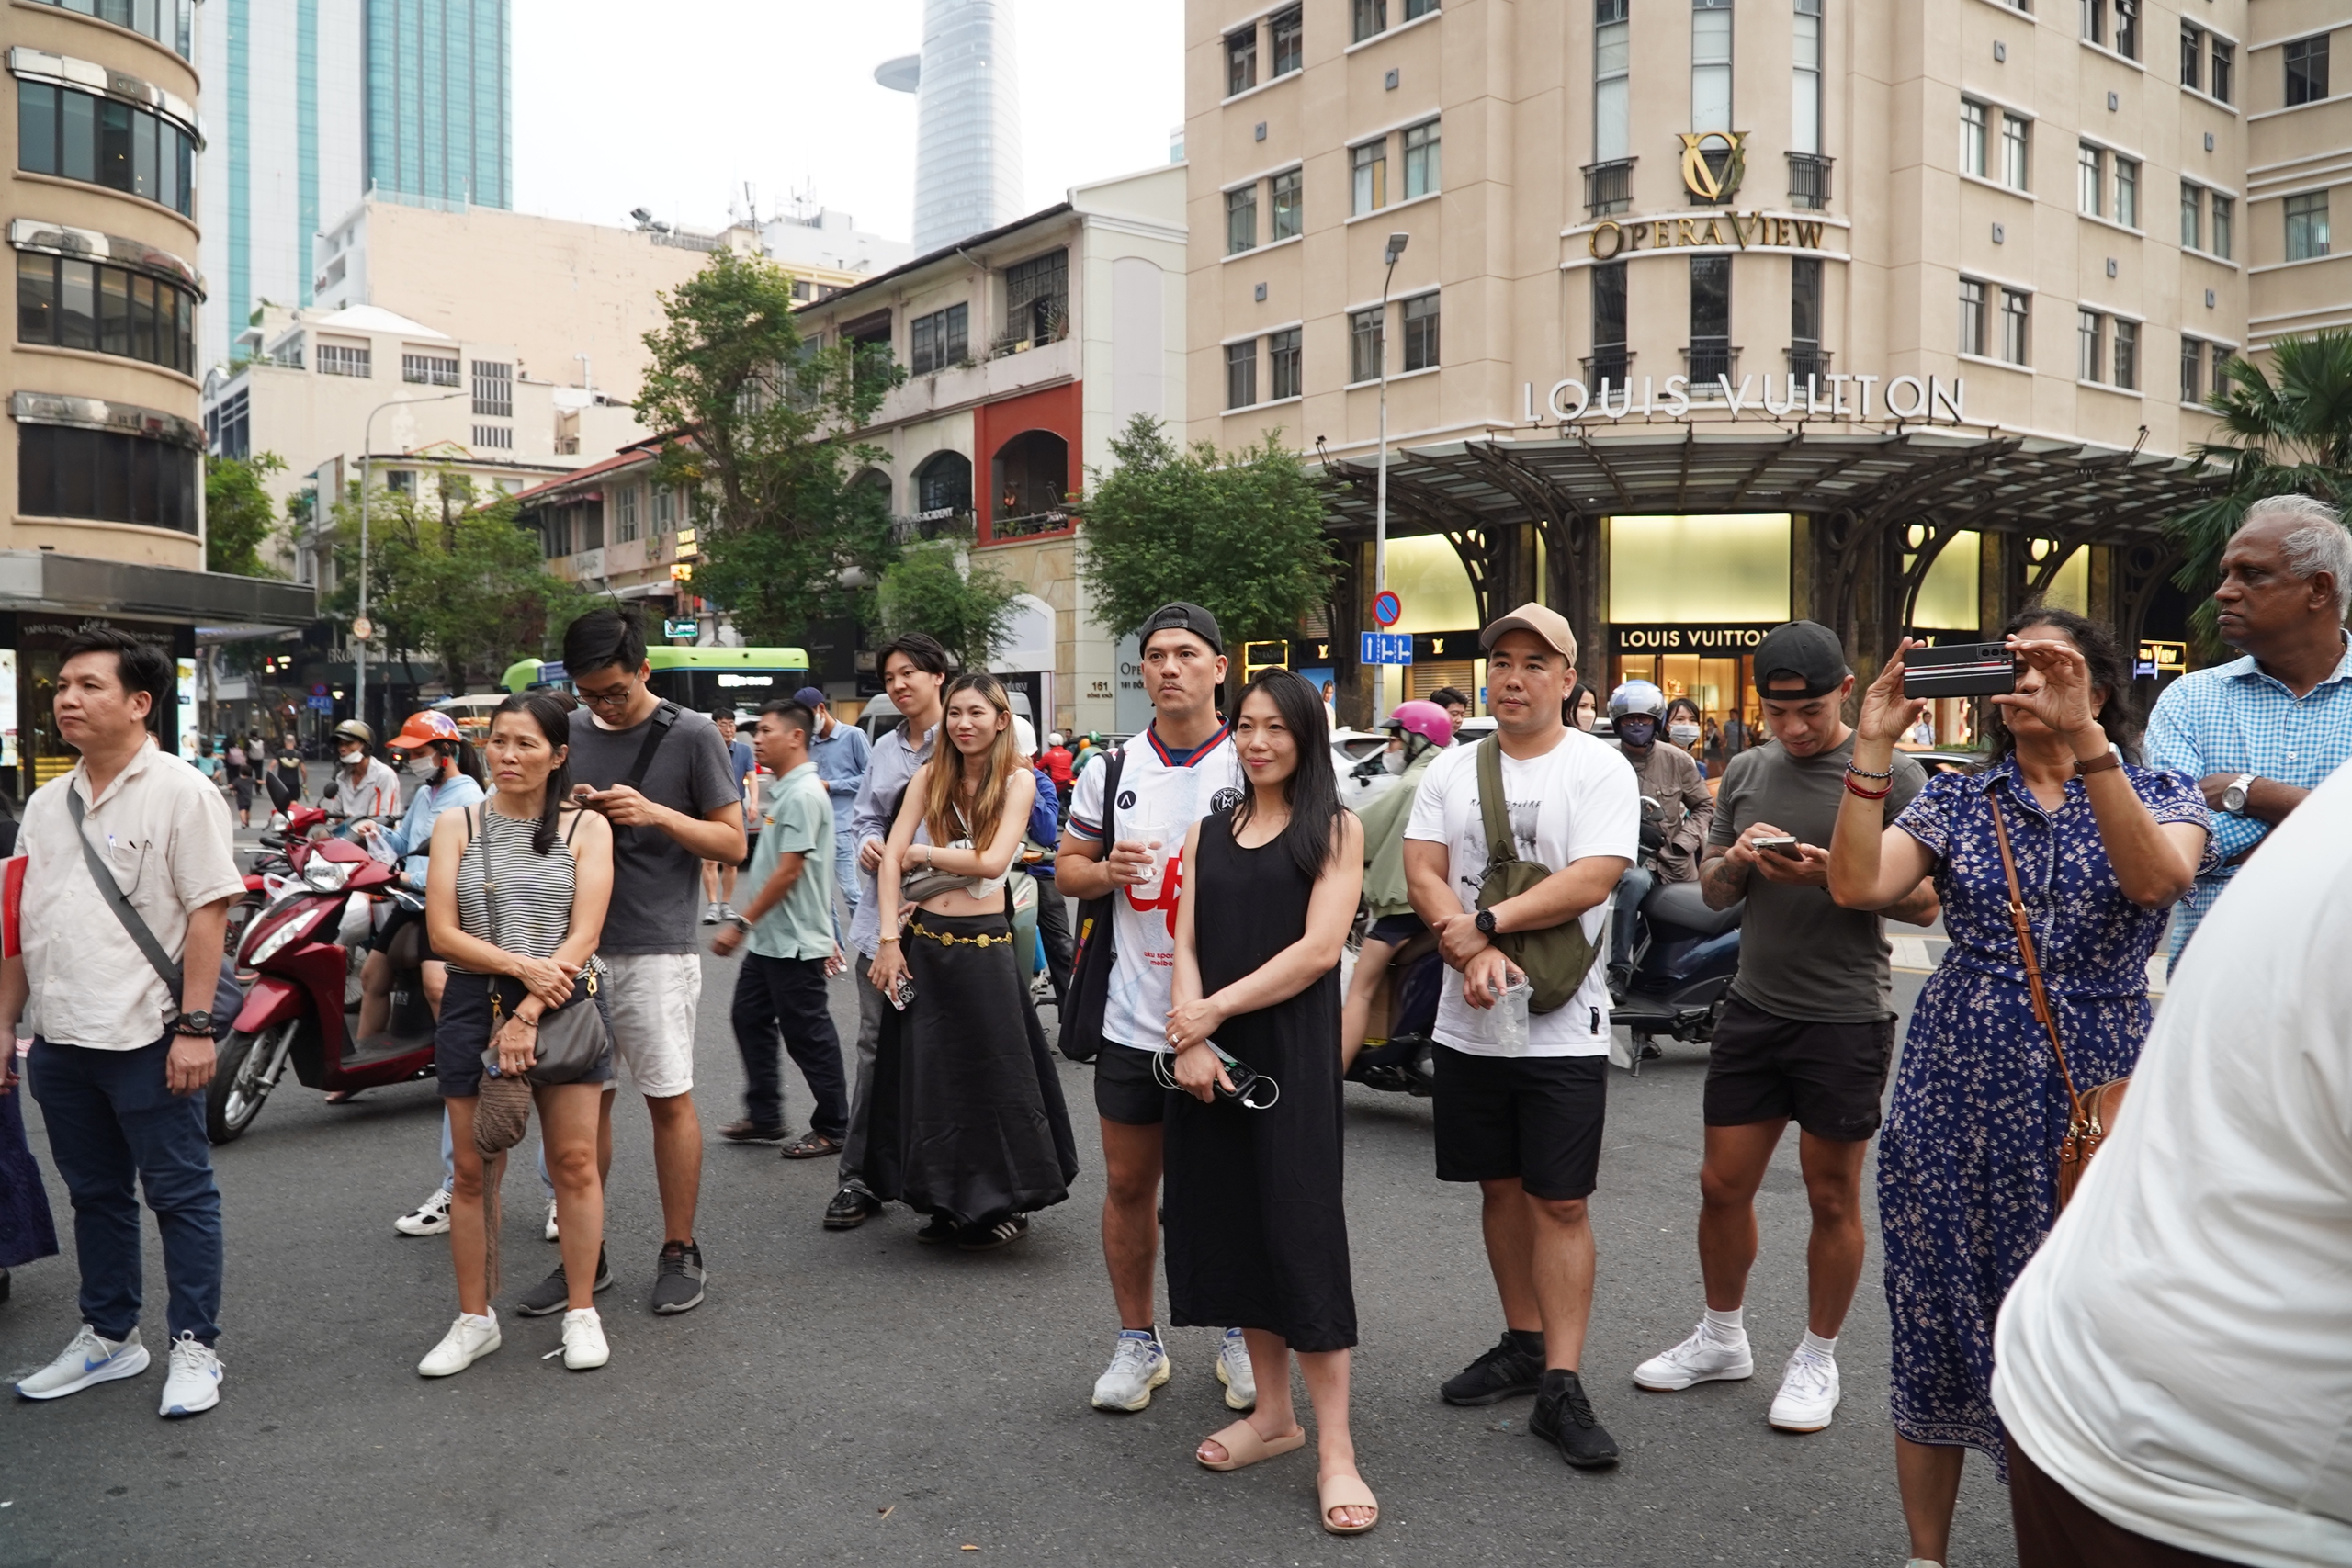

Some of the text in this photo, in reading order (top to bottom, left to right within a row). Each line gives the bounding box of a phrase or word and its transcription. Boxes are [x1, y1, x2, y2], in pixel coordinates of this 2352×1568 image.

[1524, 373, 1965, 422] LOUIS VUITTON
[1621, 630, 1680, 647] LOUIS
[1120, 662, 1142, 675] OPE
[1092, 682, 1108, 692] 161
[1157, 953, 1174, 961] spor
